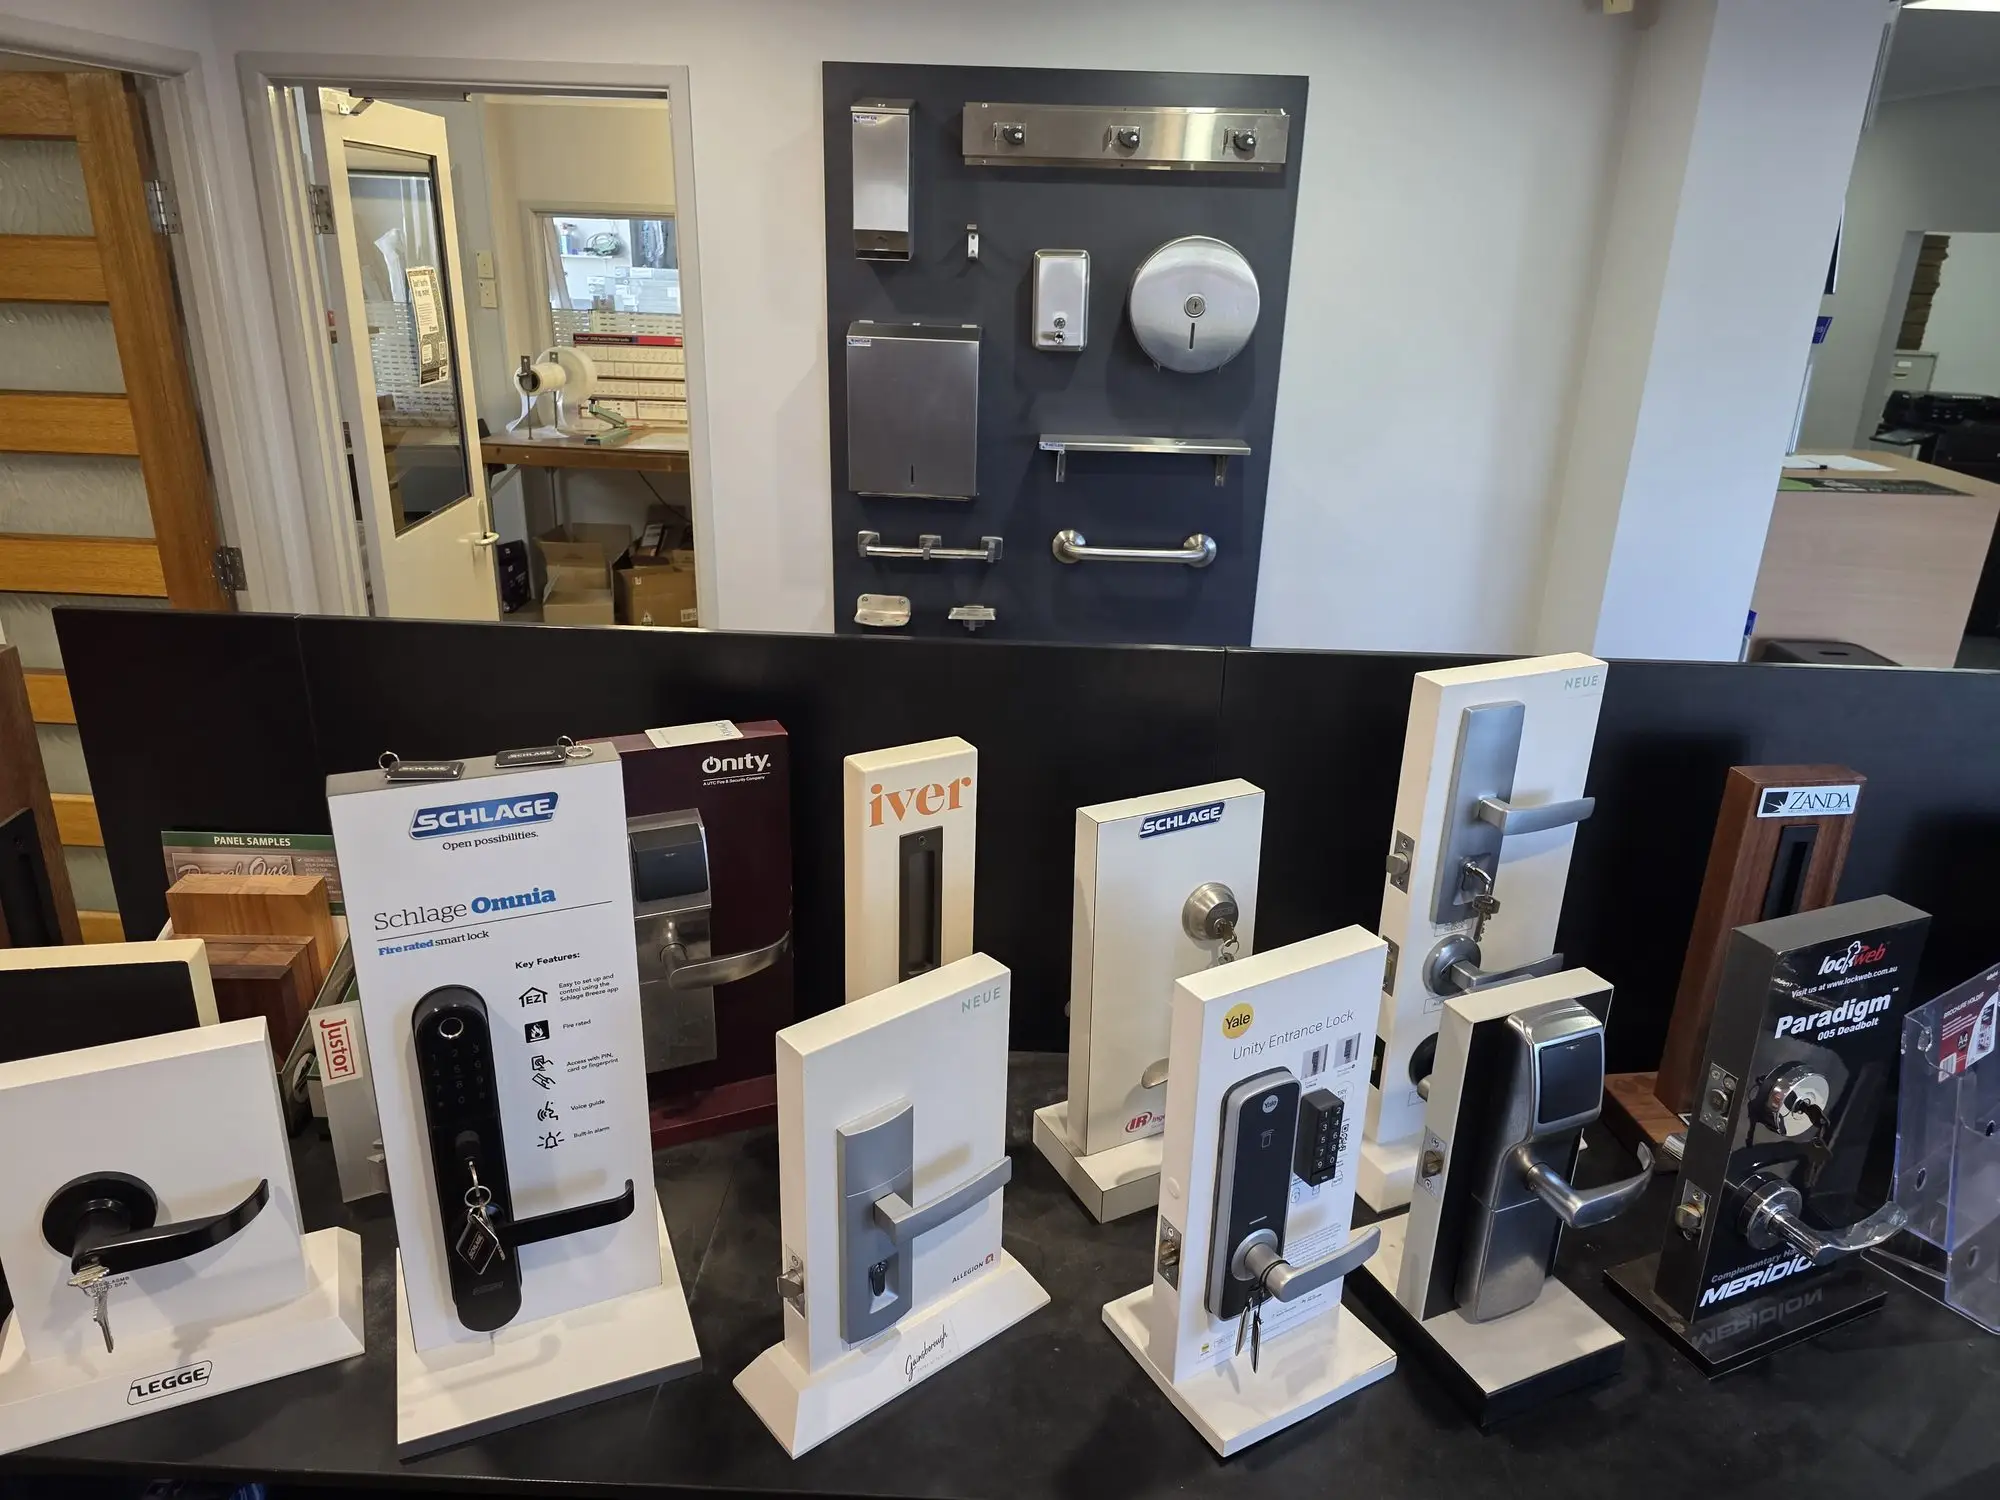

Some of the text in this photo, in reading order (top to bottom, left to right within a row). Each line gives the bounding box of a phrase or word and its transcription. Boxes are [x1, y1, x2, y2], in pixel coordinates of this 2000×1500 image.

[1564, 675, 1599, 691] NEUE
[869, 776, 972, 828] iver
[1789, 791, 1852, 809] ZANDA
[410, 798, 555, 832] SCHLAGE
[1140, 806, 1221, 835] SCHLAGE
[214, 836, 291, 847] PANEL SAMPLES
[442, 830, 539, 851] Open possibilities.
[374, 887, 557, 931] Schlage Omnia
[378, 930, 490, 956] Fire rated smart lock
[515, 952, 580, 969] Key Features:
[560, 986, 581, 995] control
[1791, 966, 1898, 998] Visit us at www.lockweb.com.au
[560, 994, 584, 1002] Schlage
[585, 989, 606, 997] Breeze
[962, 986, 1001, 1014] NEUE
[575, 1018, 592, 1026] rated
[1225, 1013, 1251, 1030] Yale
[1774, 994, 1892, 1039] Paradigm
[1233, 1009, 1355, 1060] Unity Entrance Lock
[1817, 1017, 1880, 1041] 005 Deadbolt
[319, 1018, 349, 1073] Justor
[566, 1058, 587, 1067] Access
[588, 1057, 619, 1069] fingerprint
[570, 1099, 605, 1111] Voice guide
[1336, 1106, 1342, 1115] 2
[1322, 1119, 1340, 1132] 3 4
[1320, 1131, 1338, 1144] 5 6
[1331, 1143, 1337, 1152] 8
[1317, 1160, 1323, 1169] 9
[1329, 1155, 1335, 1164] 0
[952, 1261, 984, 1284] ALLEGION
[1711, 1253, 1781, 1283] Complementary
[905, 1323, 949, 1382] Gainsborough
[131, 1367, 209, 1398] LEGGE
